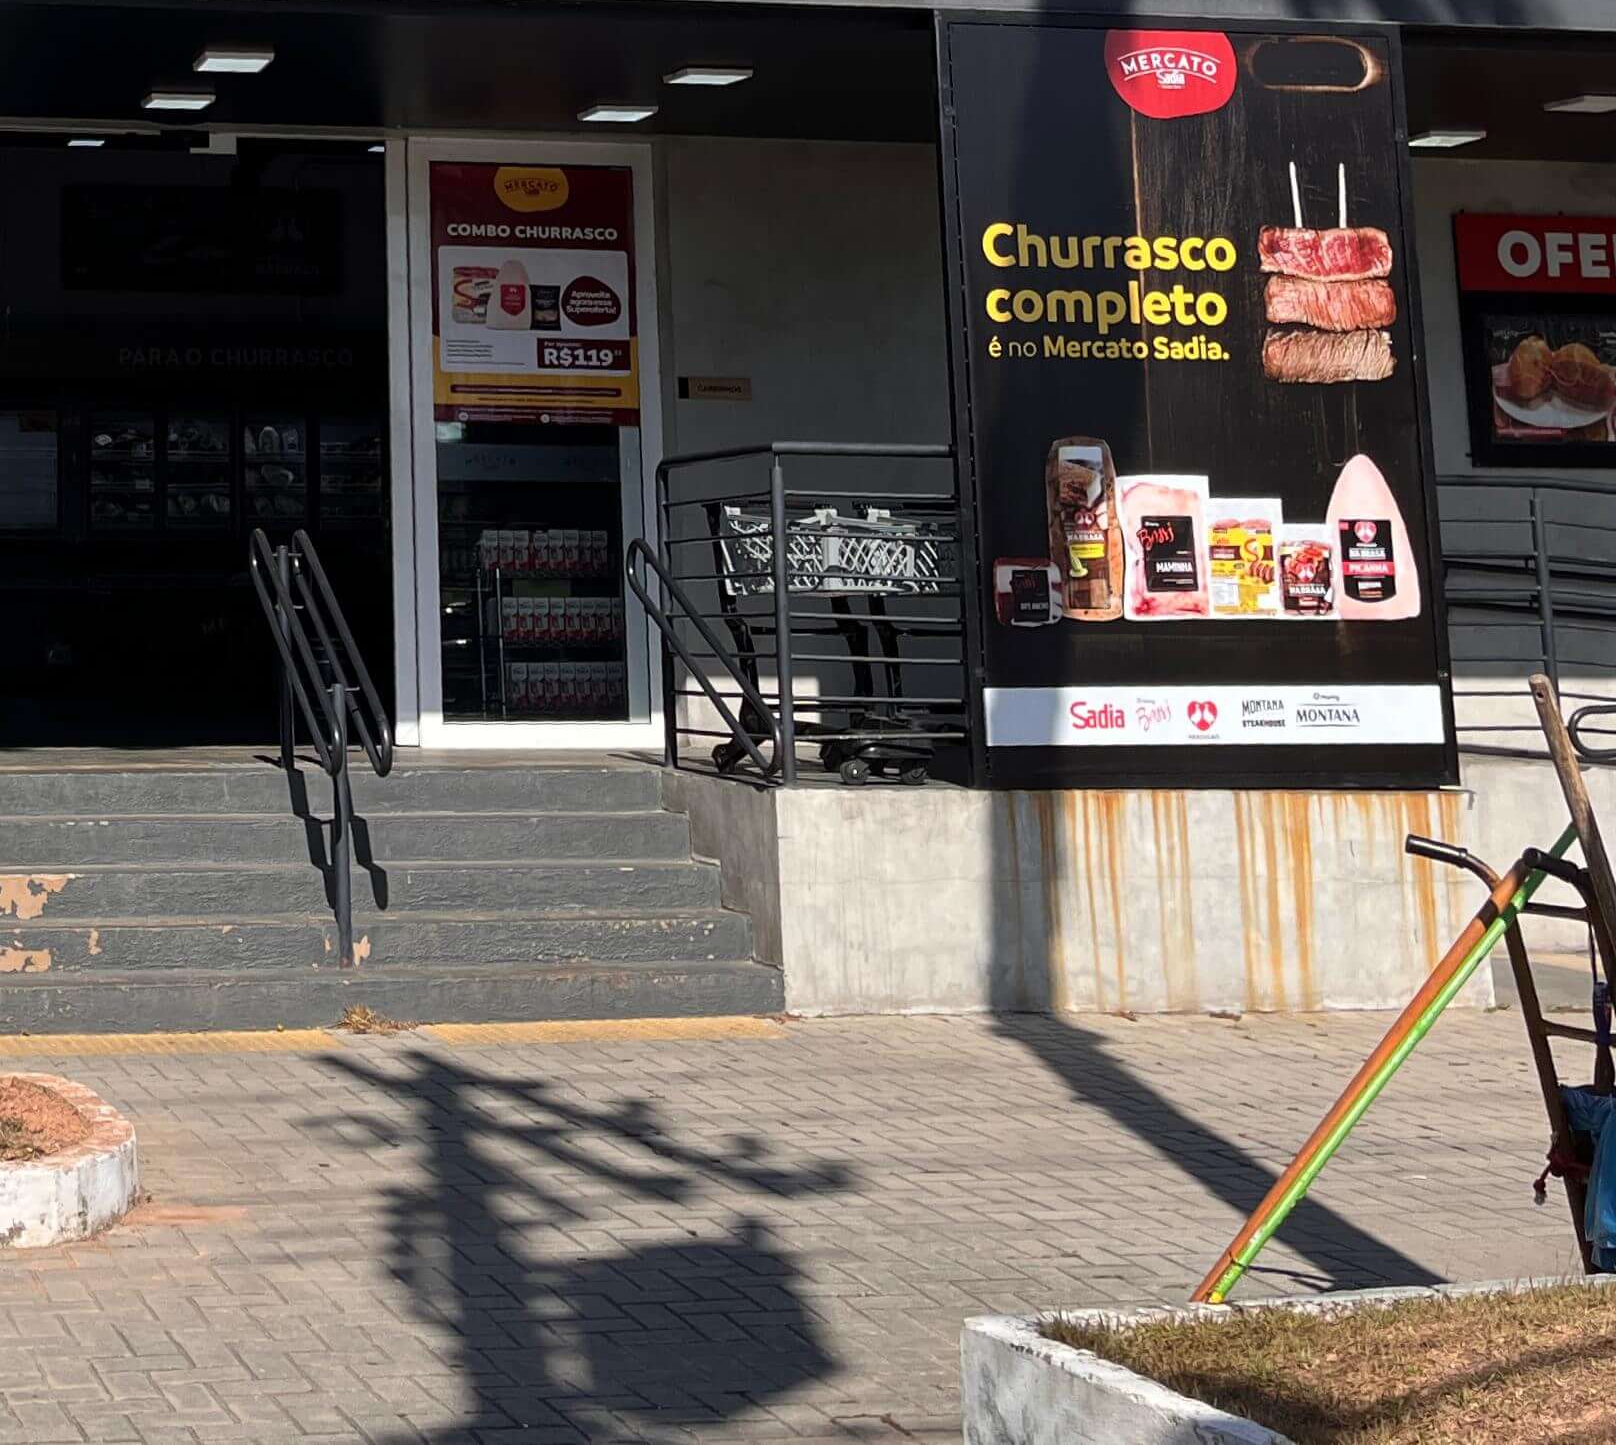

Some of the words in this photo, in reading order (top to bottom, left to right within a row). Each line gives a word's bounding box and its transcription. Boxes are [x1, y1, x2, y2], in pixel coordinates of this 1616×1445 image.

[1121, 53, 1217, 76] MERCATO
[1156, 69, 1185, 84] Sadia
[504, 178, 559, 193] MERCATO
[447, 224, 511, 238] COMBO
[515, 225, 618, 241] CHURRASCO
[982, 222, 1237, 271] Churrasco
[1497, 230, 1616, 278] OFE
[986, 281, 1228, 334] completo
[209, 347, 353, 366] CHURRASCO
[543, 348, 613, 366] R$119
[988, 335, 1002, 358] é
[1008, 339, 1037, 358] no
[1044, 336, 1149, 359] Mercato
[1154, 337, 1230, 361] Sadia.
[1155, 561, 1193, 573] MAMINHA
[1071, 701, 1125, 730] Sadia
[1242, 699, 1284, 717] MONTANA
[1296, 708, 1361, 723] MONTANA
[1242, 719, 1286, 728] STEAKHOUSE
